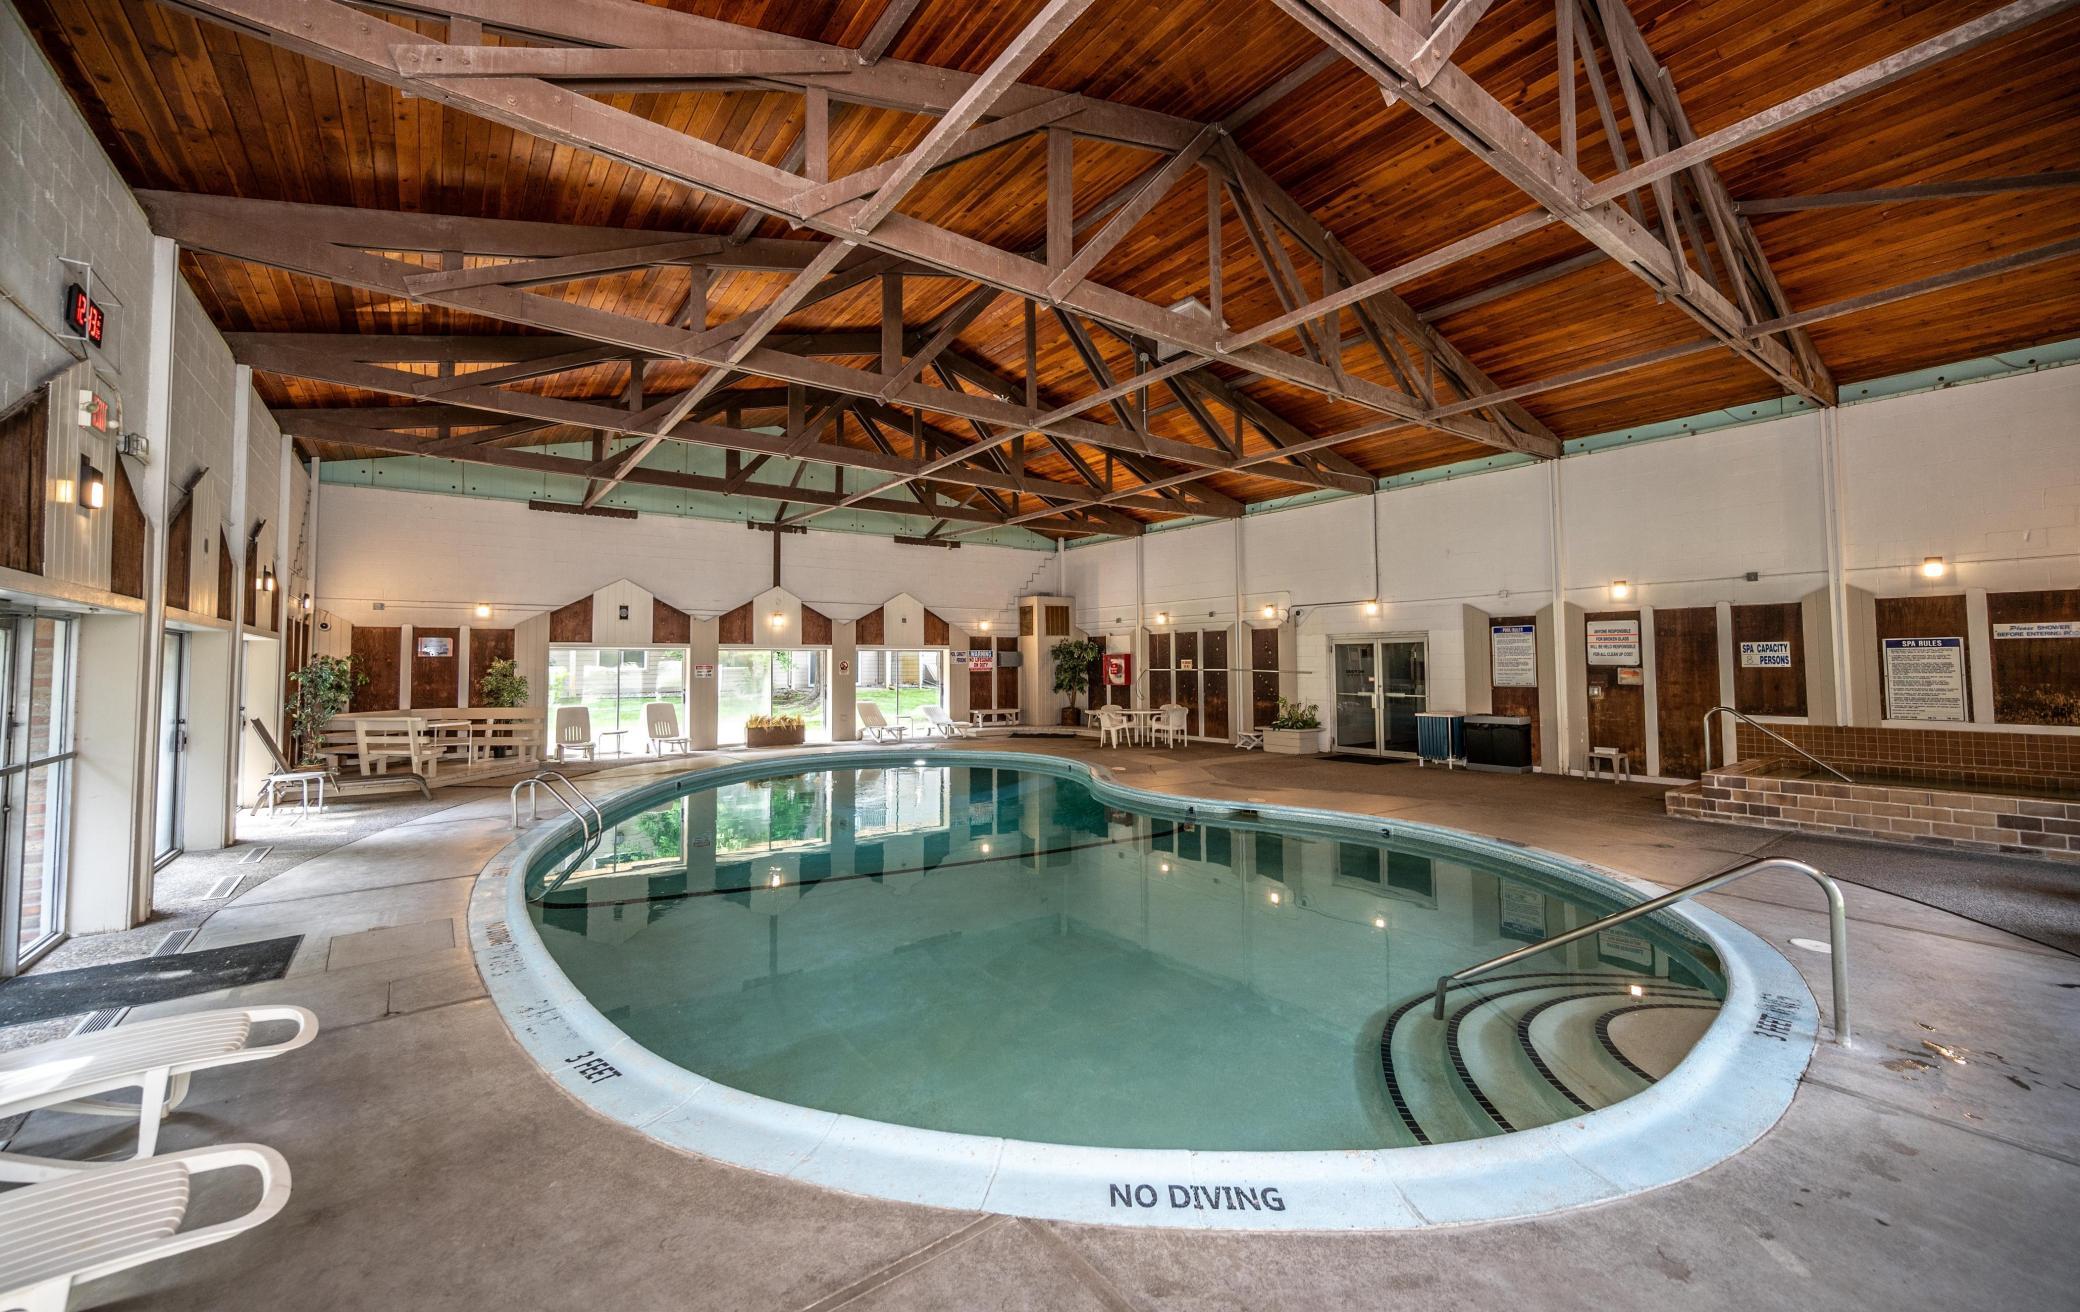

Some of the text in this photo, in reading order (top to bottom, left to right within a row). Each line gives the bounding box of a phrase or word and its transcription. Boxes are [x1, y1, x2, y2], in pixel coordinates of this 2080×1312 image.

[1742, 643, 1788, 653] SPA CAPACITY
[1918, 639, 1942, 647] RULES
[1760, 655, 1790, 665] PERSONS
[1756, 1013, 1792, 1036] FEET
[1753, 1031, 1787, 1041] 3
[565, 1051, 622, 1084] 3 FEET
[1109, 1183, 1286, 1211] NO DIVING
